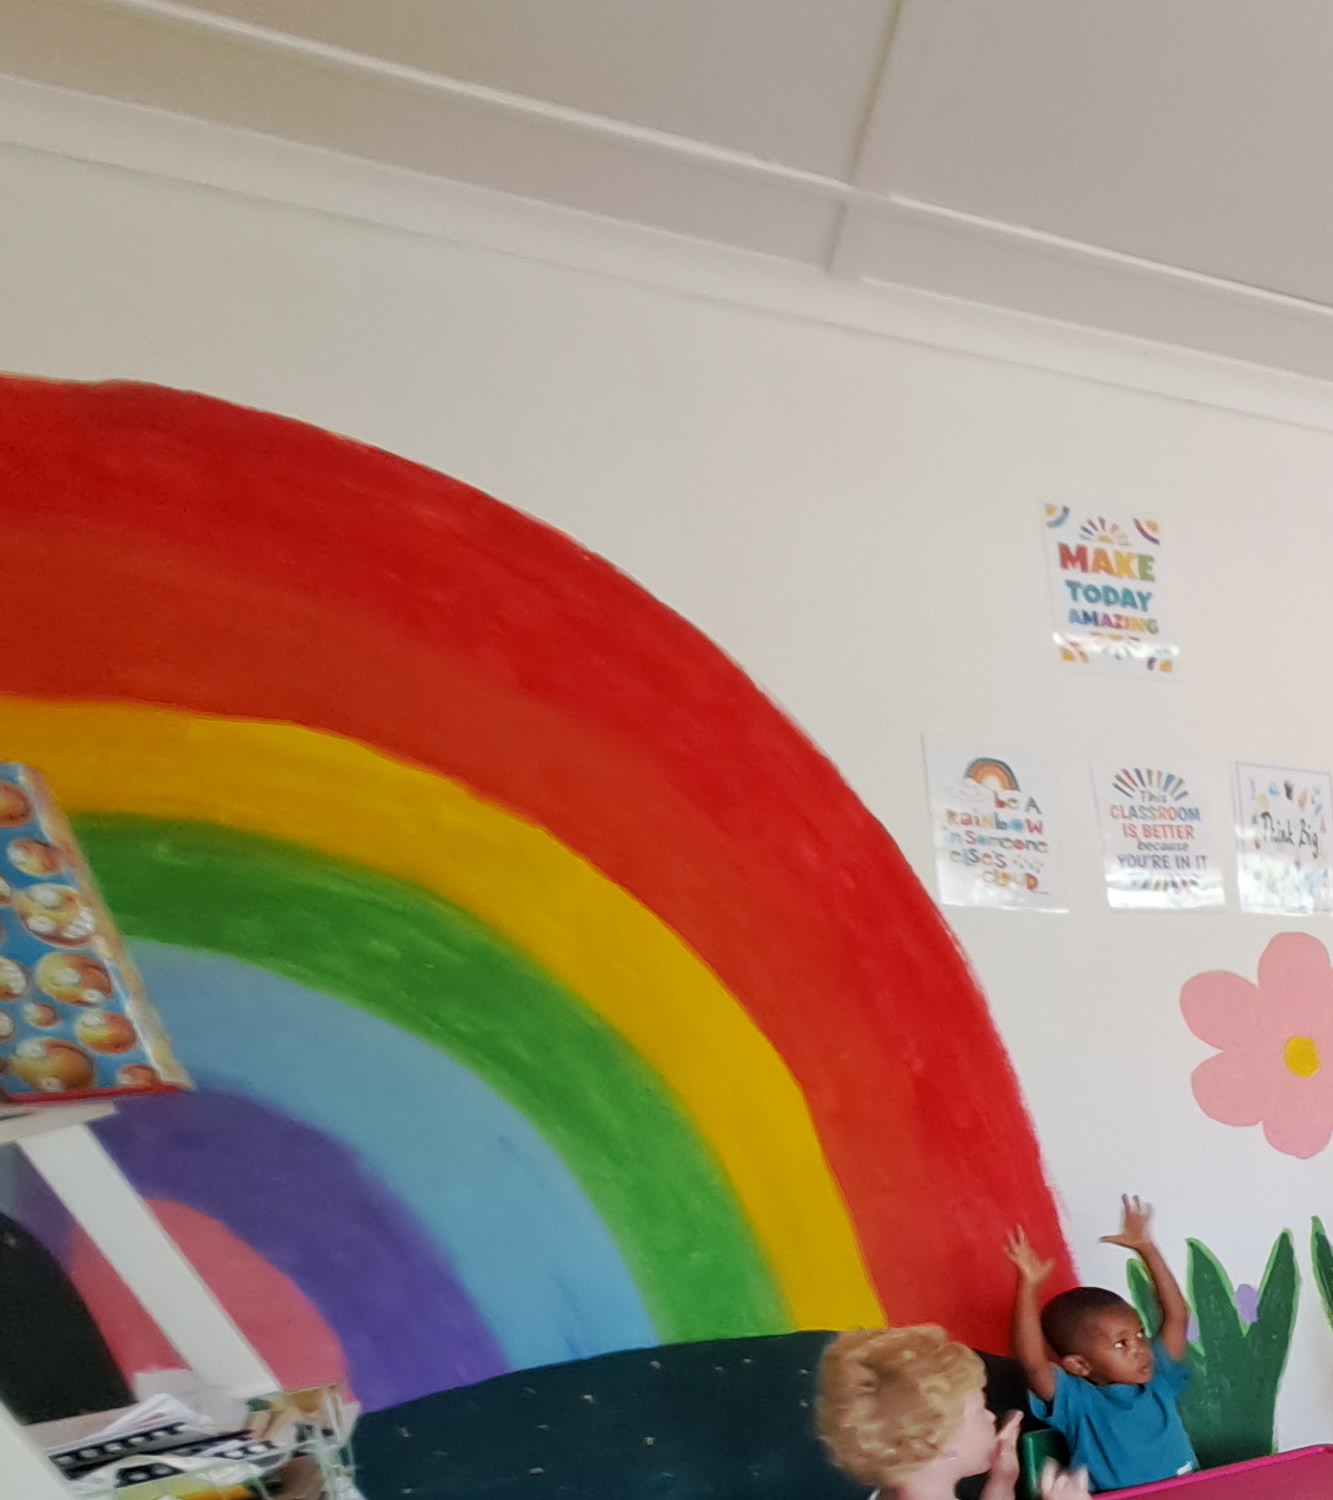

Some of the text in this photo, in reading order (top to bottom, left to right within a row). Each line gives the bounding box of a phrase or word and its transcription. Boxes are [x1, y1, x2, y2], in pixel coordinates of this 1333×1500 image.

[1058, 541, 1156, 582] MAKE
[1065, 579, 1153, 612] TODAY
[1068, 608, 1160, 634] AMAZING
[1109, 804, 1202, 822] CLASSROOM
[1122, 823, 1196, 840] IS BETTER
[1137, 839, 1190, 852] because
[1116, 854, 1209, 869] YOU'RE IN IT
